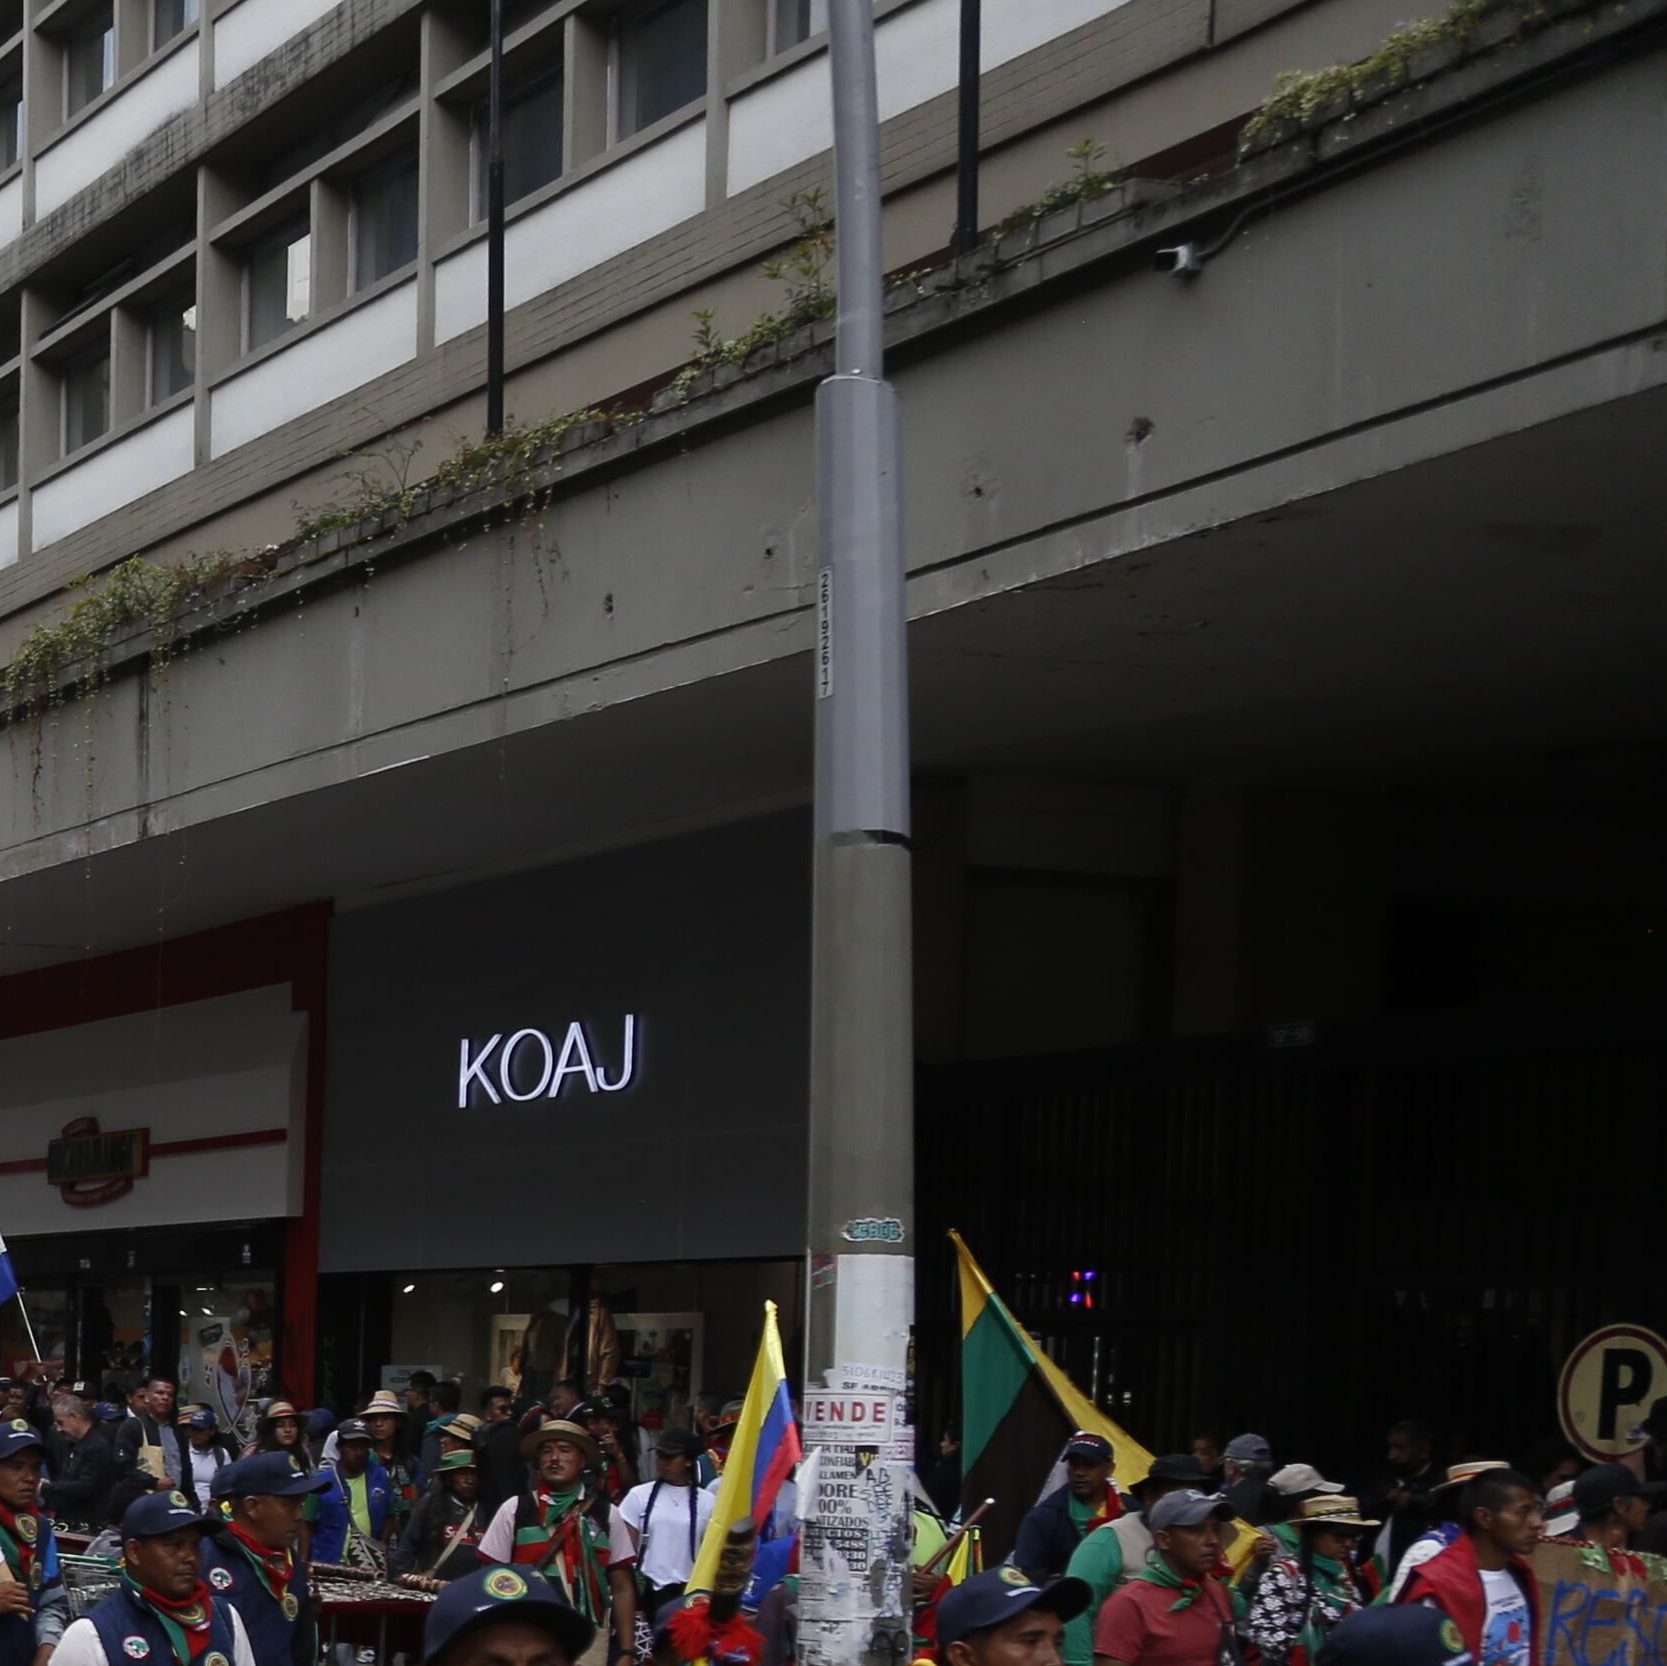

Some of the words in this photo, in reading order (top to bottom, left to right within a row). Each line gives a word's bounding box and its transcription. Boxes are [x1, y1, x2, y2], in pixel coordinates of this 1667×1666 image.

[458, 1013, 635, 1109] KOAJ
[1596, 1348, 1653, 1441] P
[818, 1499, 851, 1514] 00%
